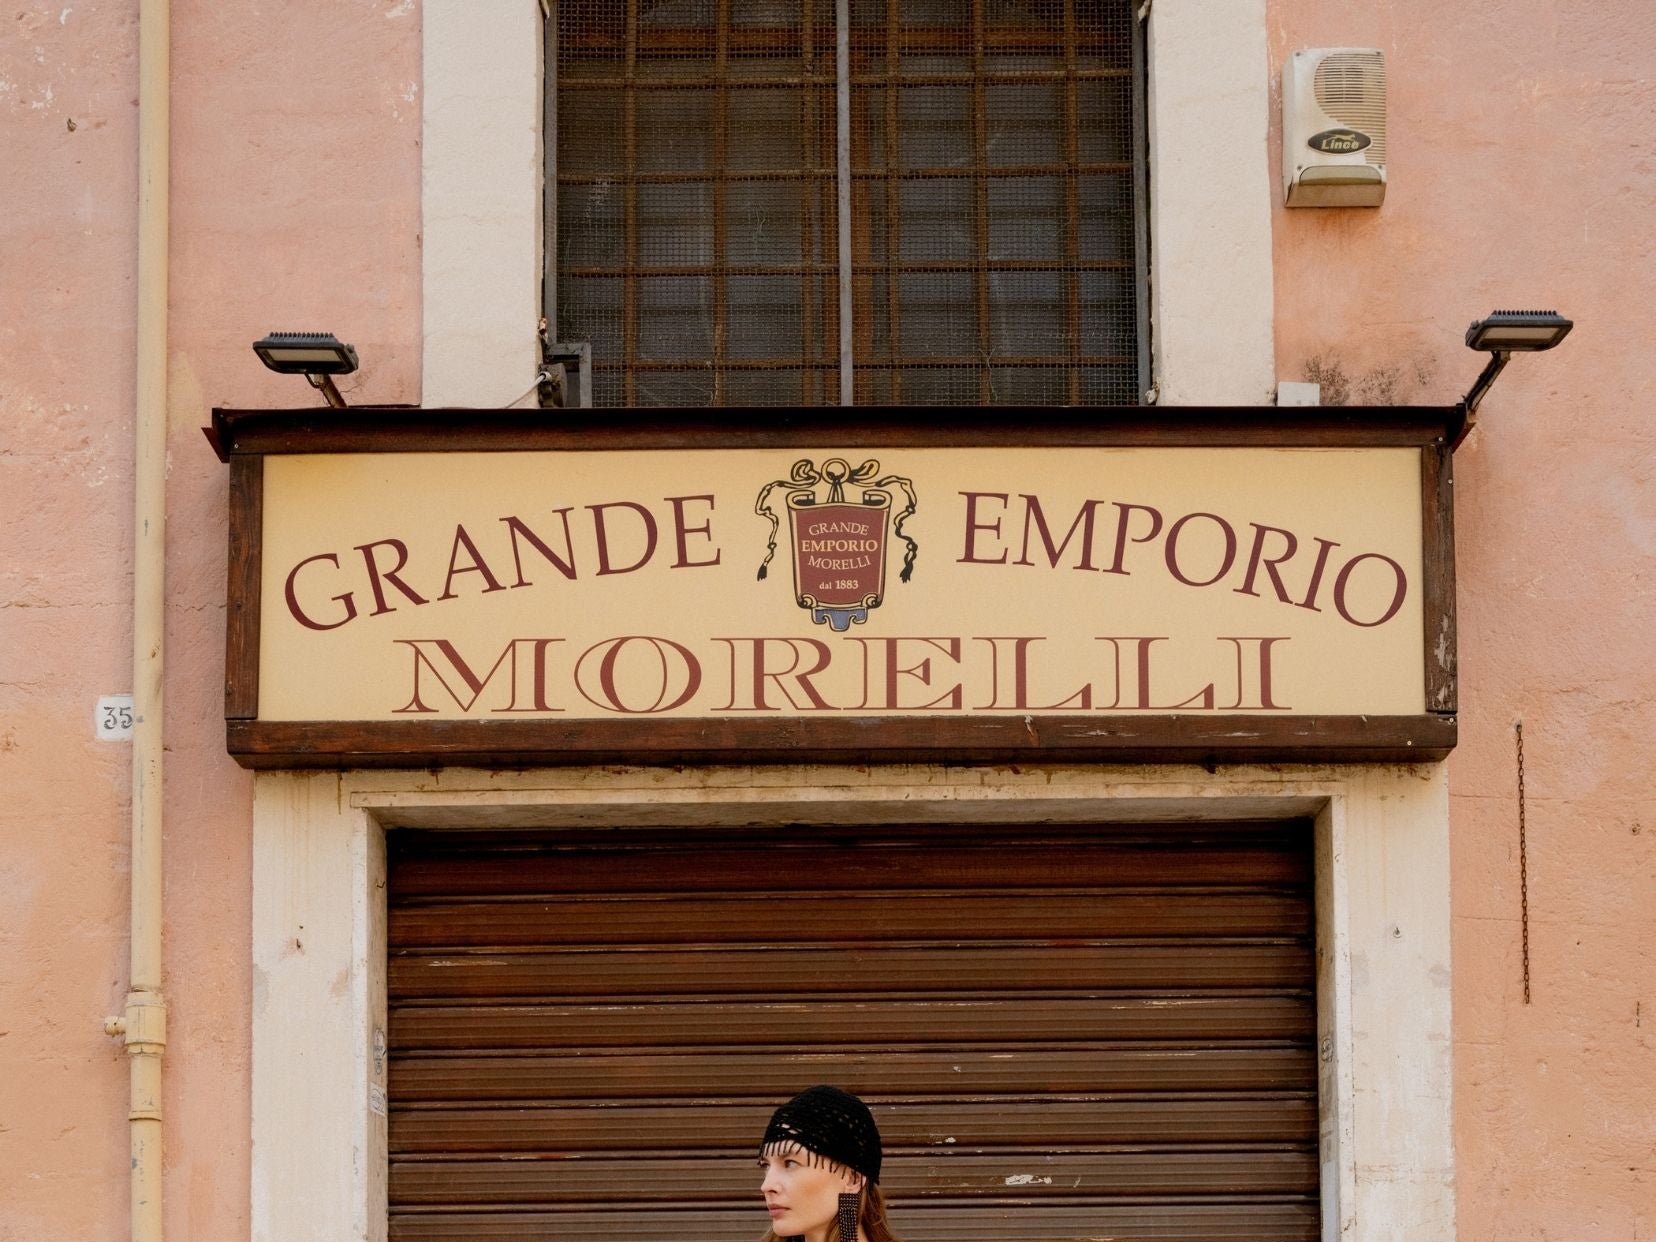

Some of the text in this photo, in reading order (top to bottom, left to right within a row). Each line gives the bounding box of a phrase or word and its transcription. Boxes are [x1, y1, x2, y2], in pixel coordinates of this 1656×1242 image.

[808, 522, 869, 536] GRANDE
[801, 540, 878, 552] EMPORIO
[283, 490, 1408, 632] GRANDE EMPORIO
[808, 555, 871, 570] MORELLI
[819, 579, 859, 590] dal 1883
[391, 635, 1293, 714] MORELLI
[103, 706, 133, 730] 35
